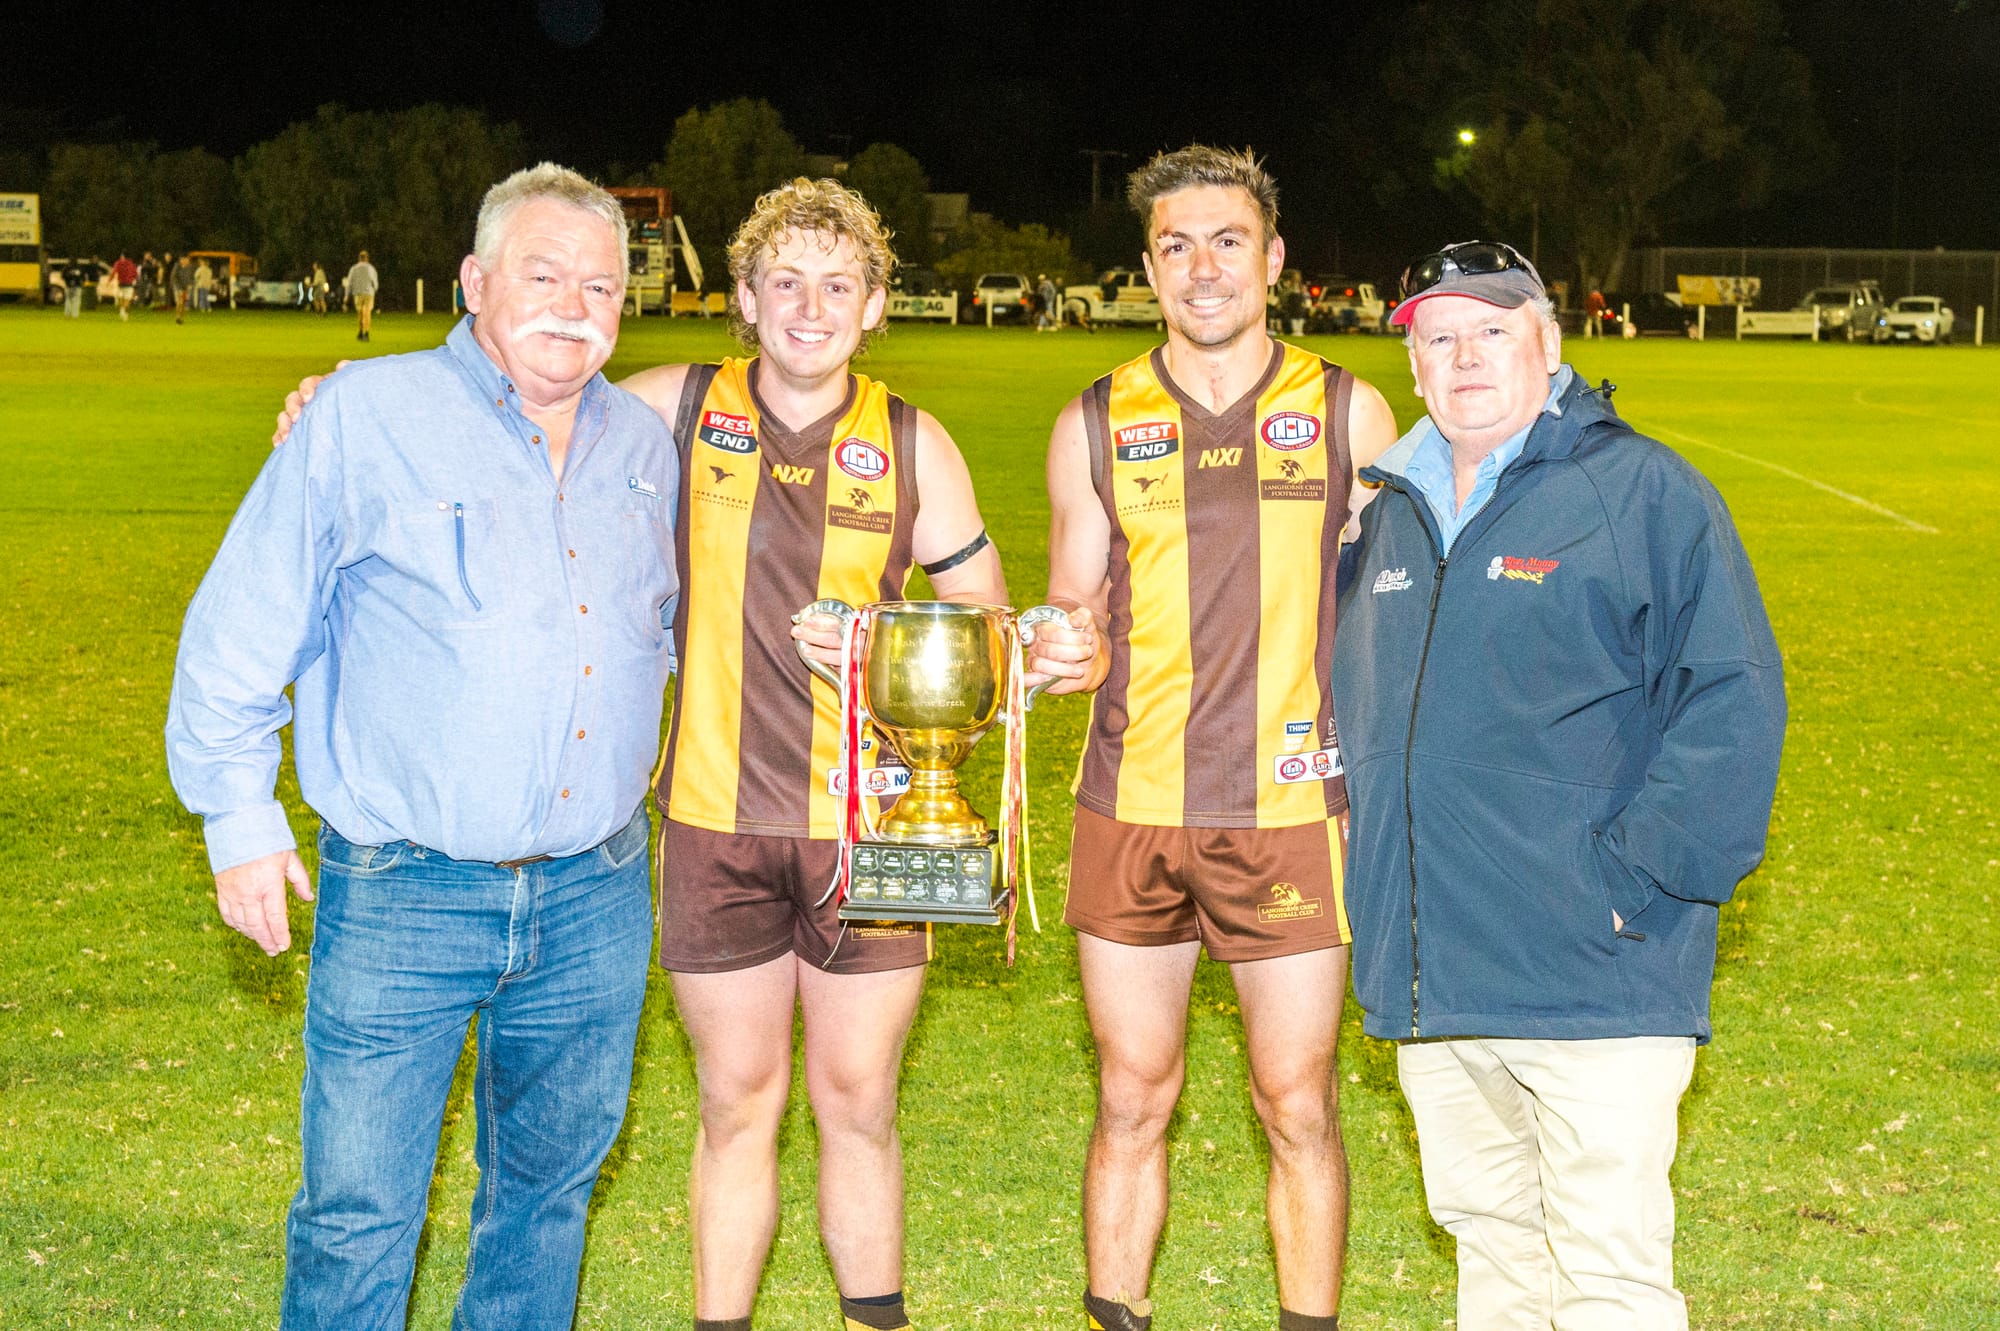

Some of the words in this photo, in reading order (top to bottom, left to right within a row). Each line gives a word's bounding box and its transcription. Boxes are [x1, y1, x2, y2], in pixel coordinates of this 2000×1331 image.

[893, 300, 909, 311] FP
[925, 301, 944, 311] AG
[709, 412, 753, 433] WEST
[1120, 424, 1172, 443] WEST
[710, 431, 750, 451] END
[1269, 440, 1295, 450] FOOTBALL
[1128, 442, 1168, 460] END
[1198, 447, 1244, 469] NXI
[771, 463, 816, 487] NXI
[832, 510, 871, 522] LANGHORNE
[872, 515, 890, 524] CREEK
[838, 518, 869, 528] FOOTBALL
[894, 773, 910, 786] NX
[1261, 905, 1299, 915] LANGHORNE
[1268, 912, 1298, 920] FOOTBALL
[861, 930, 892, 938] FOOTBALL
